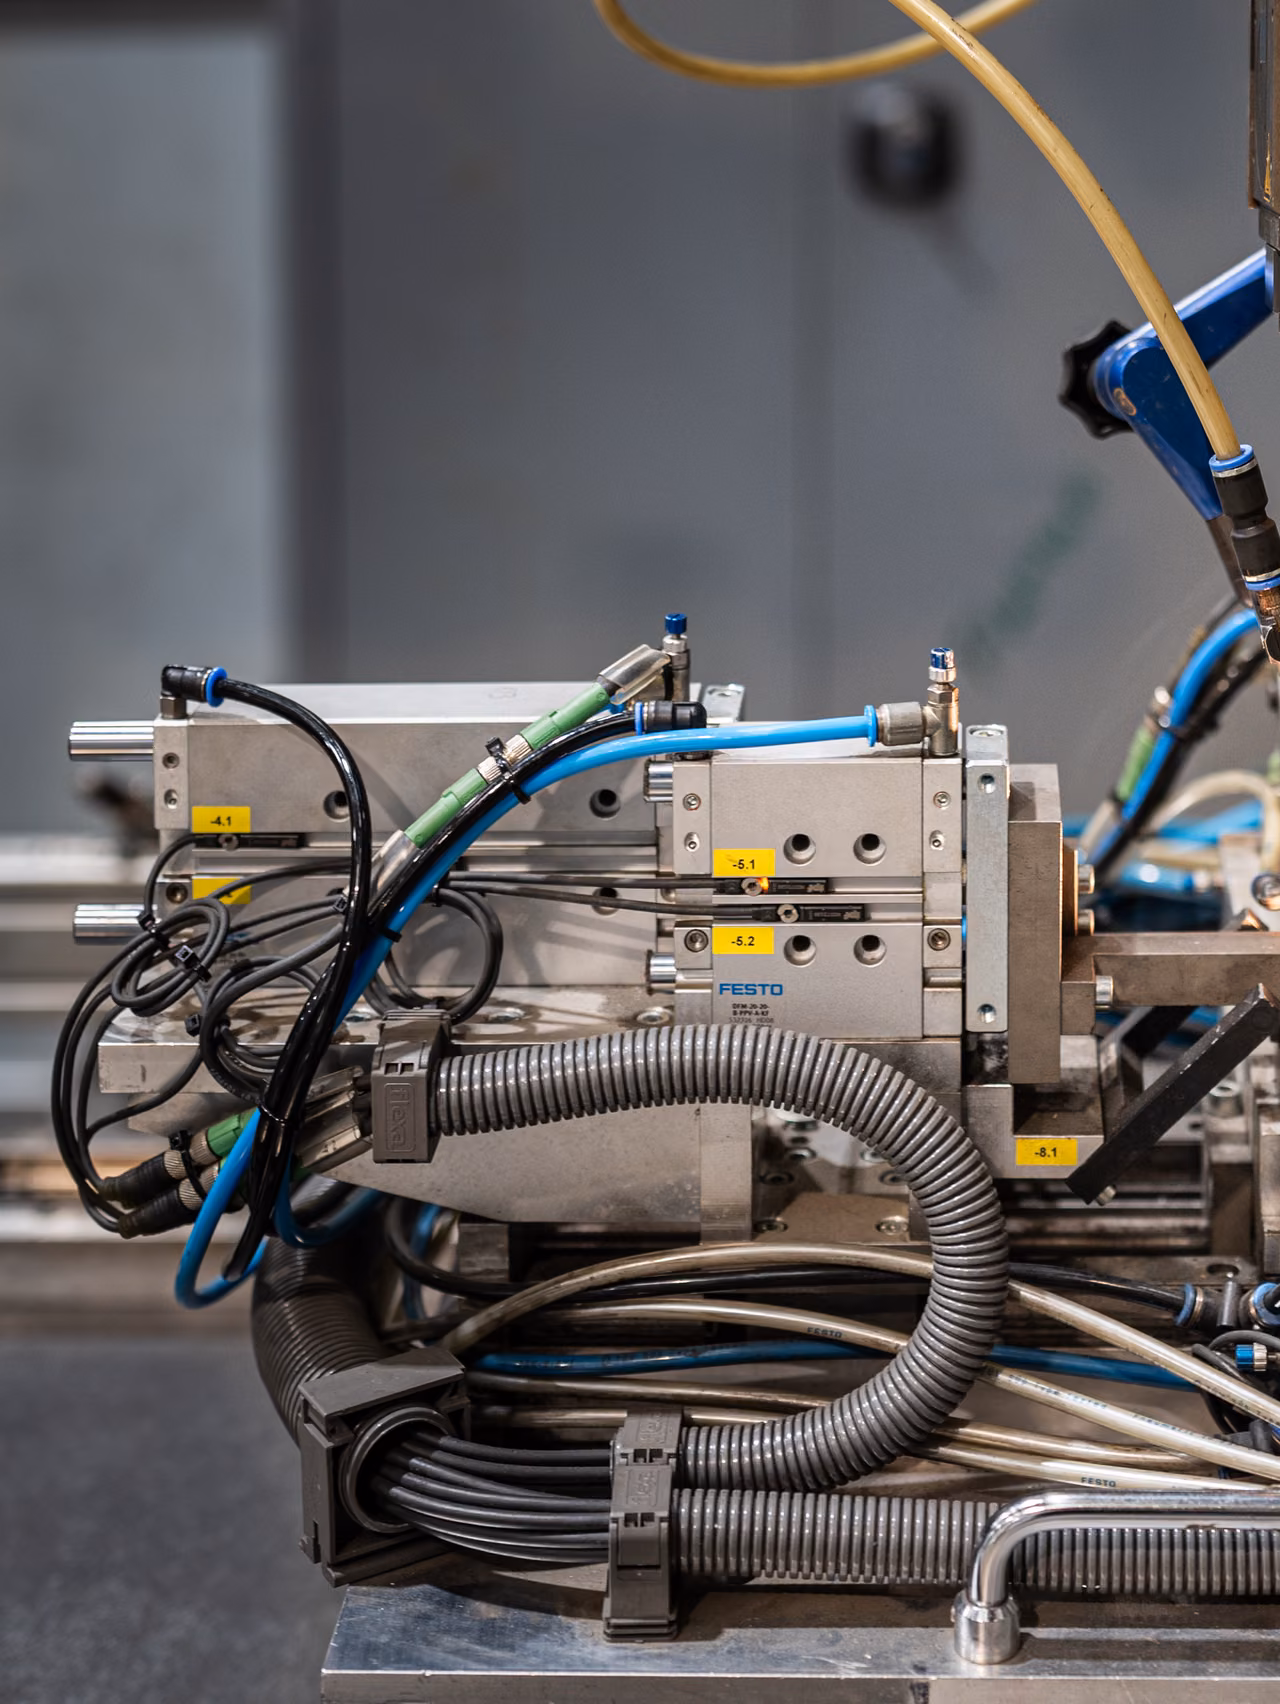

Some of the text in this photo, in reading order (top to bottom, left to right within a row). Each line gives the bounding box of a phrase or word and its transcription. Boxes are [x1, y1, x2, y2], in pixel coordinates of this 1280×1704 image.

[210, 815, 232, 827] -4.1
[732, 858, 756, 870] -5.1
[730, 935, 756, 947] -5.2
[719, 983, 784, 996] FESTO
[1033, 1146, 1058, 1158] -8.1
[807, 1326, 843, 1339] FESTO
[1080, 1476, 1117, 1489] FESTO
